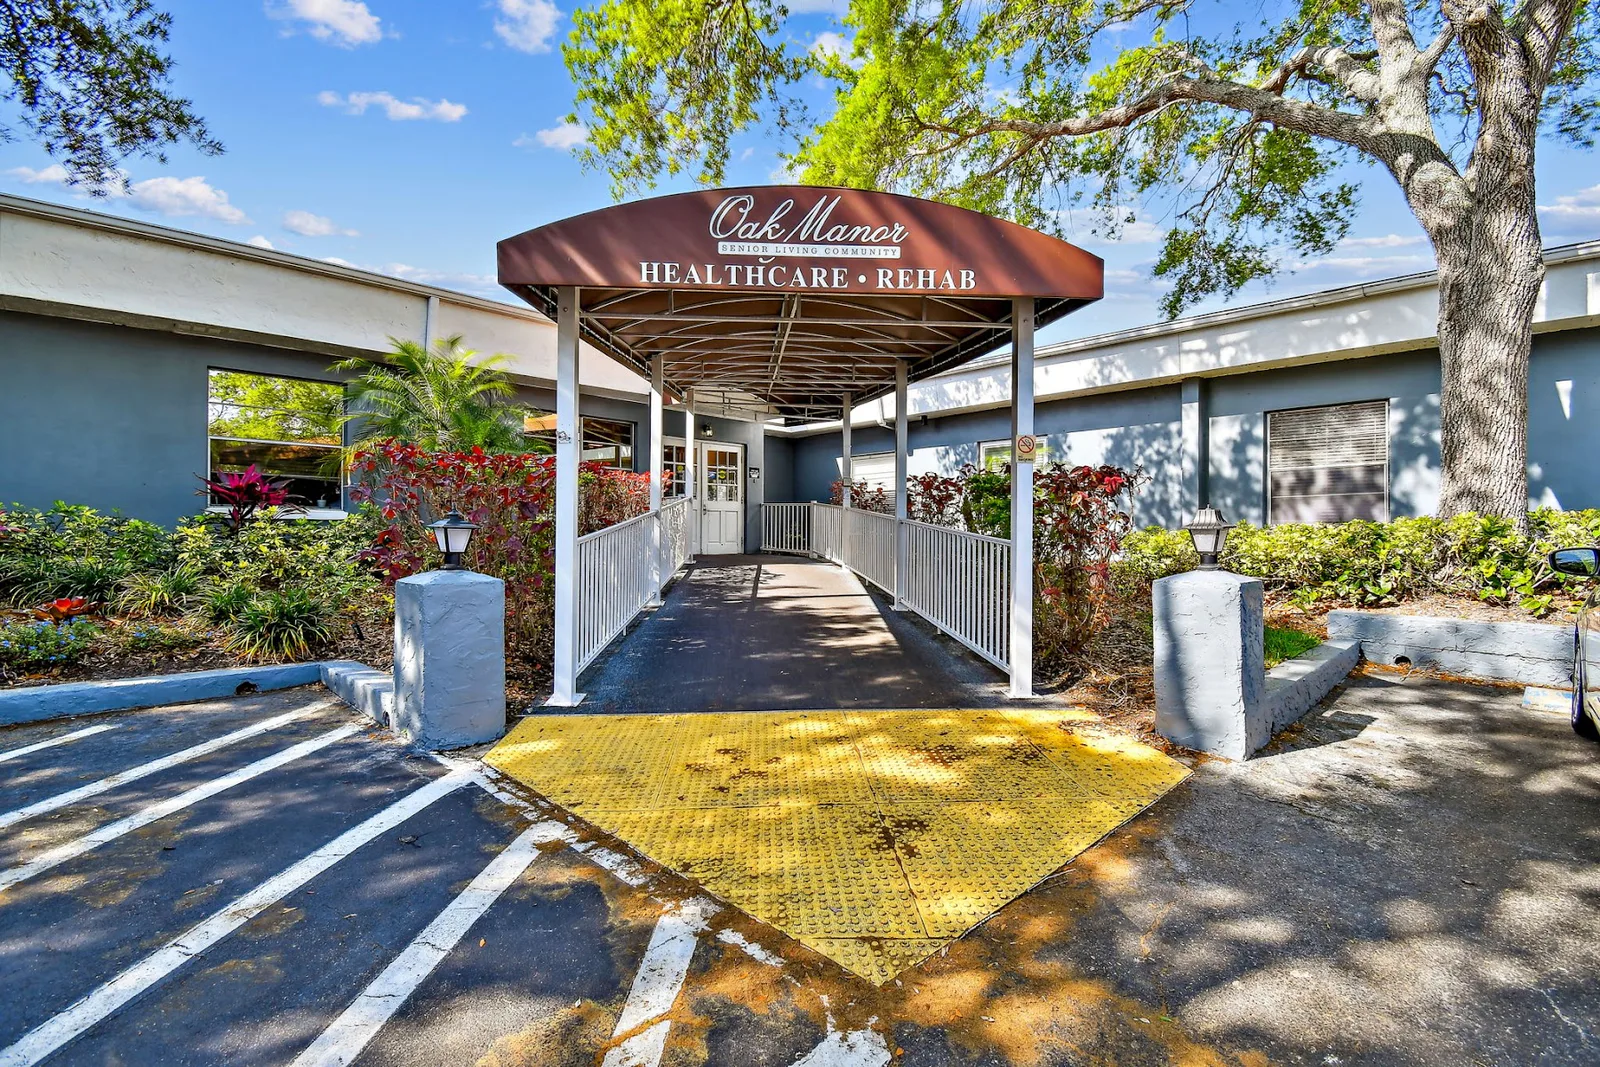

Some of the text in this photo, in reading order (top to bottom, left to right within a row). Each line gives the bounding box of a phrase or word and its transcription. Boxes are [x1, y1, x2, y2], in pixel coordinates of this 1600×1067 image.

[709, 195, 909, 243] Oak Manor
[721, 244, 898, 256] SENIOR LIVING COMMUNITY
[639, 261, 976, 290] HEALTHCARE REHAB
